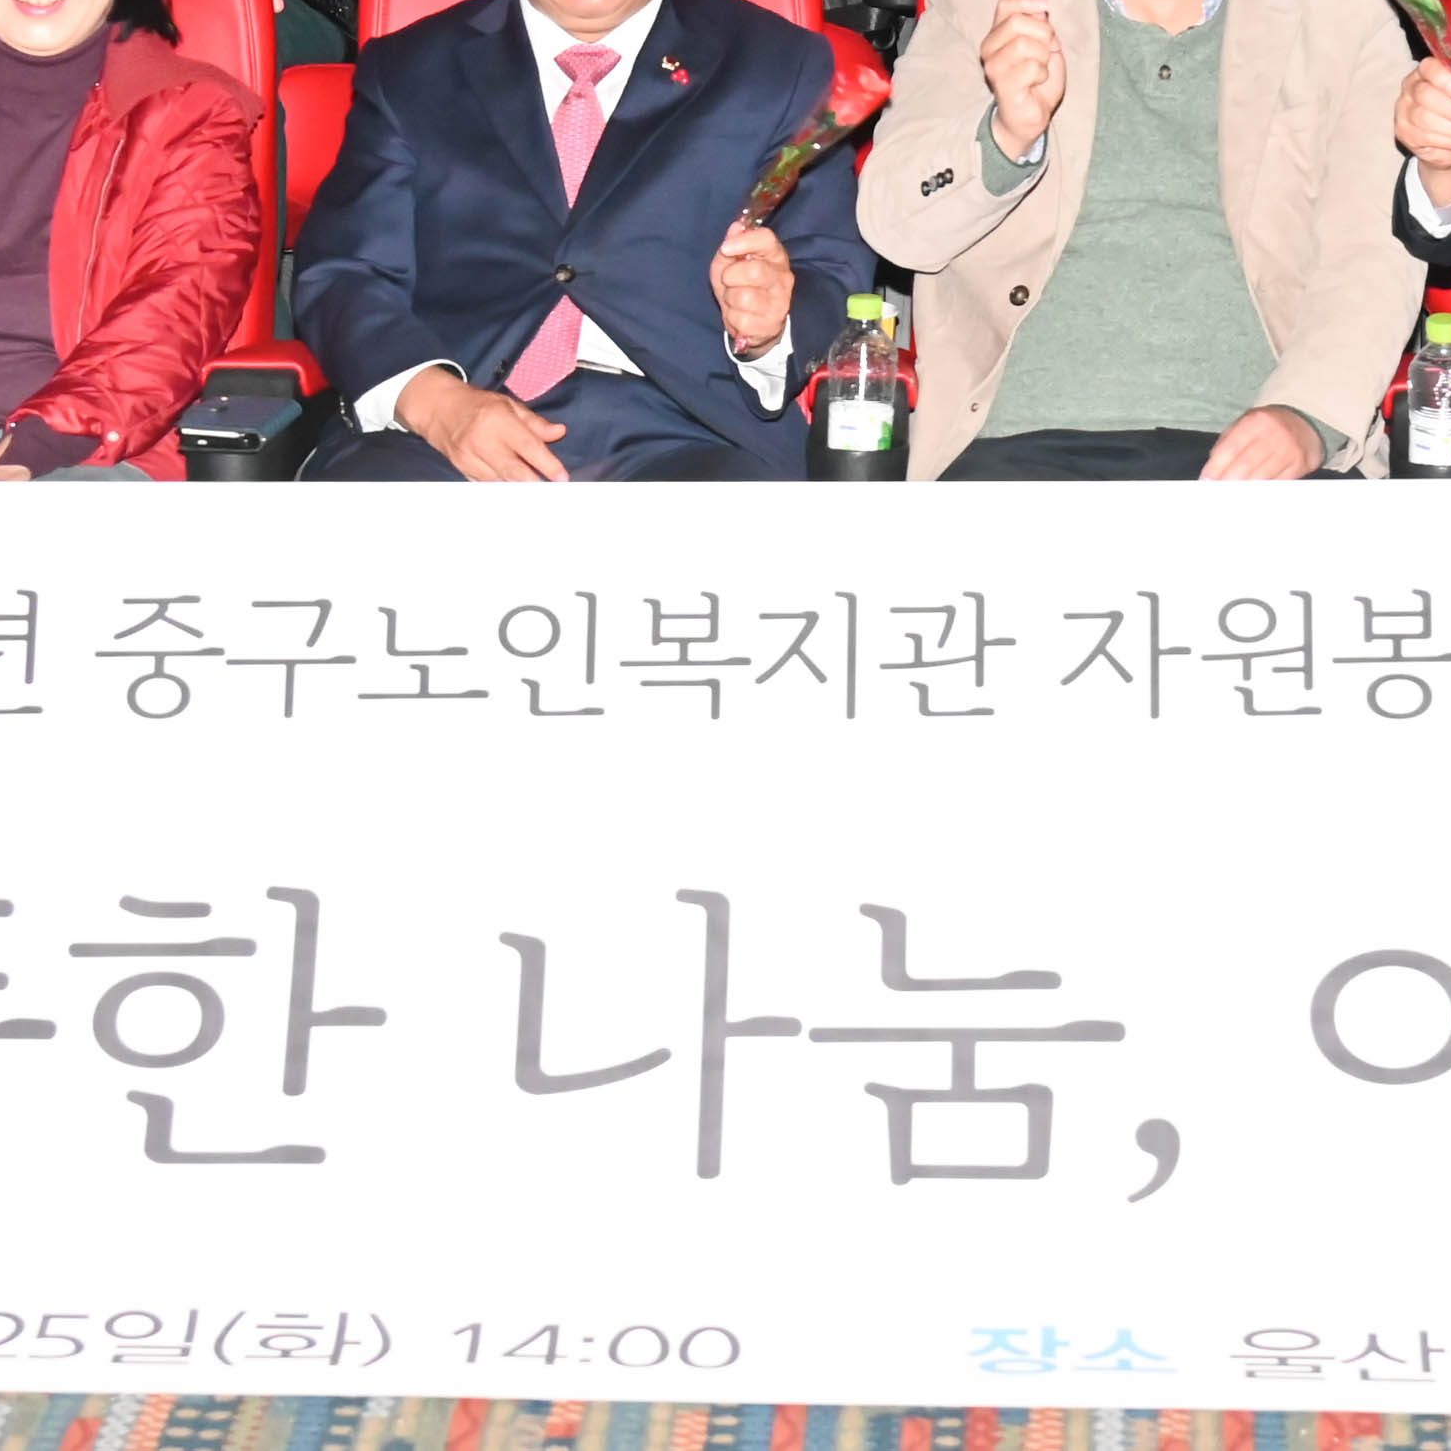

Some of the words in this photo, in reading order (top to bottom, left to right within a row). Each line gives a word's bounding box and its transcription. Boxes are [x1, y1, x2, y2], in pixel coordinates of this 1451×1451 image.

[95, 591, 1016, 720] 중구노인복지관
[499, 889, 1180, 1203] 나눔,
[452, 1323, 740, 1368] 14:00
[966, 1326, 1177, 1374] 장소
[1230, 1328, 1446, 1382] 울산
